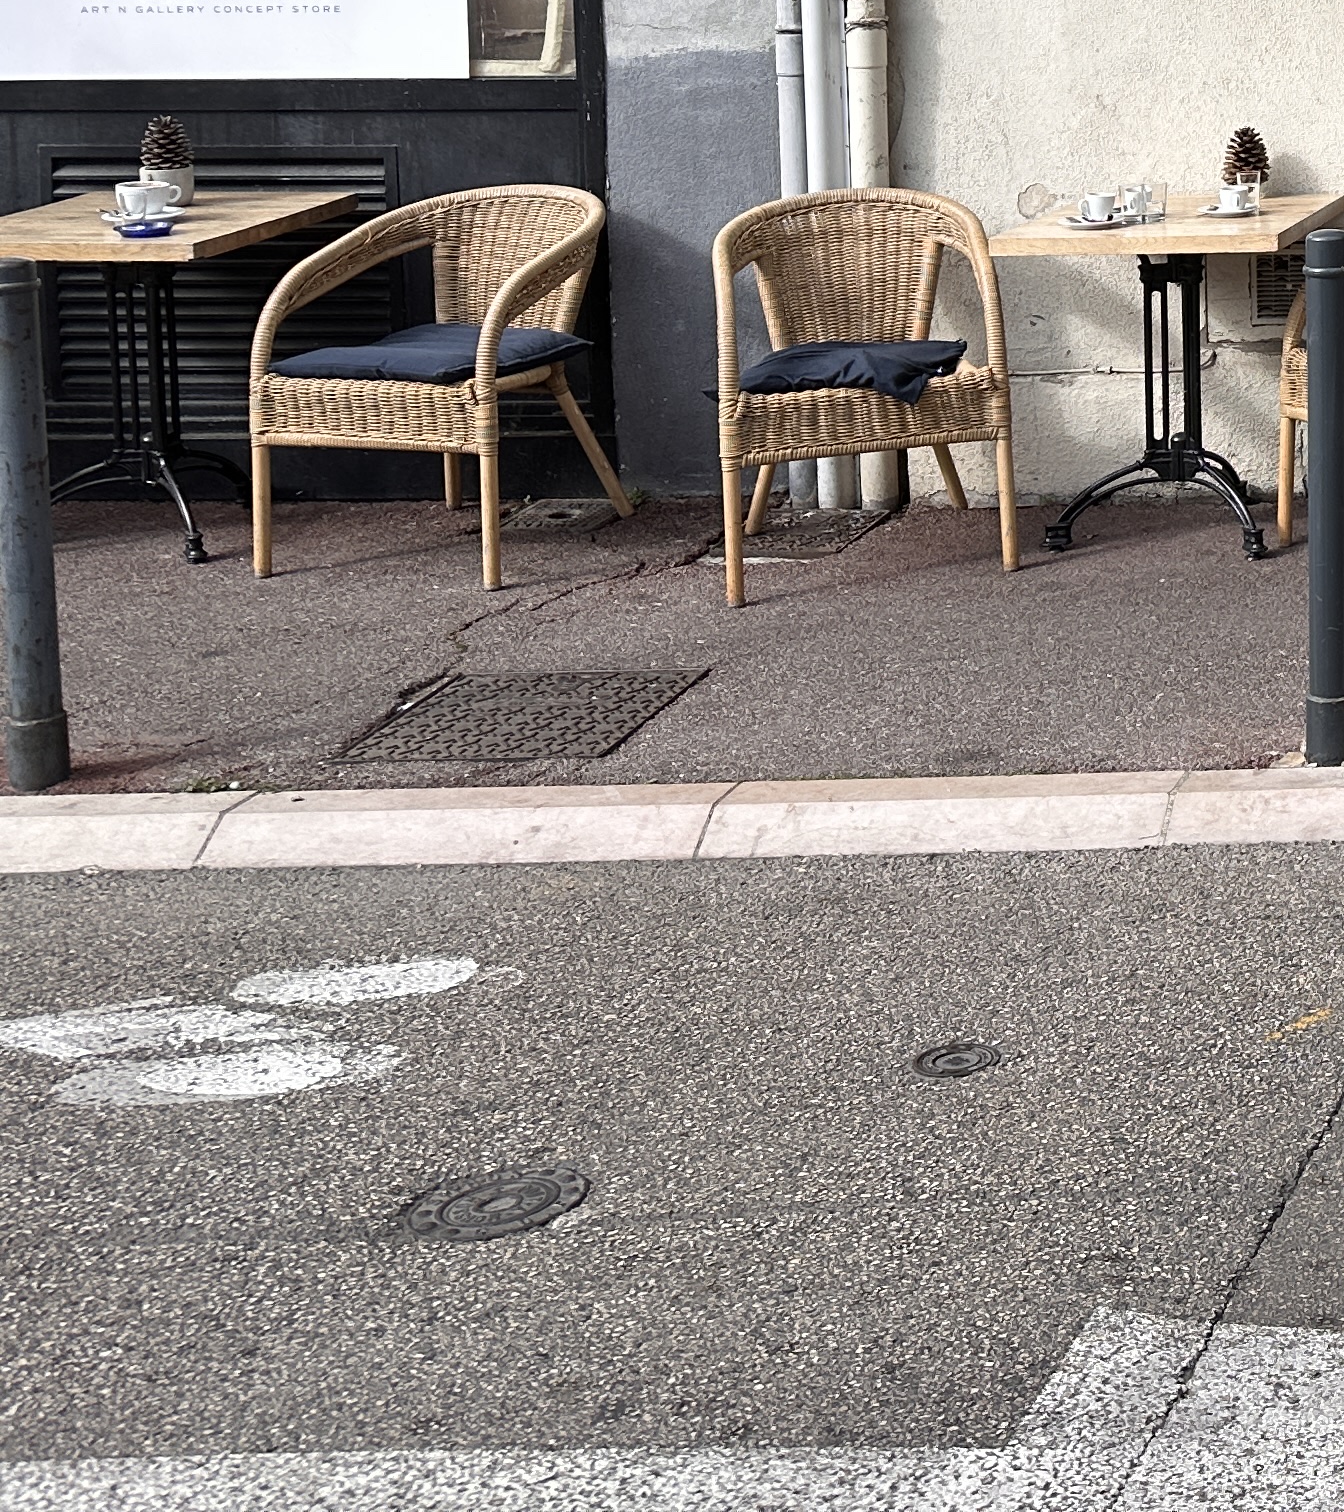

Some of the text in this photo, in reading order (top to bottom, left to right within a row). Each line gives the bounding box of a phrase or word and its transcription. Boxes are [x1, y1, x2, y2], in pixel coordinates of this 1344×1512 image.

[80, 5, 341, 14] ART N GALLERY CONCEPT STORE
